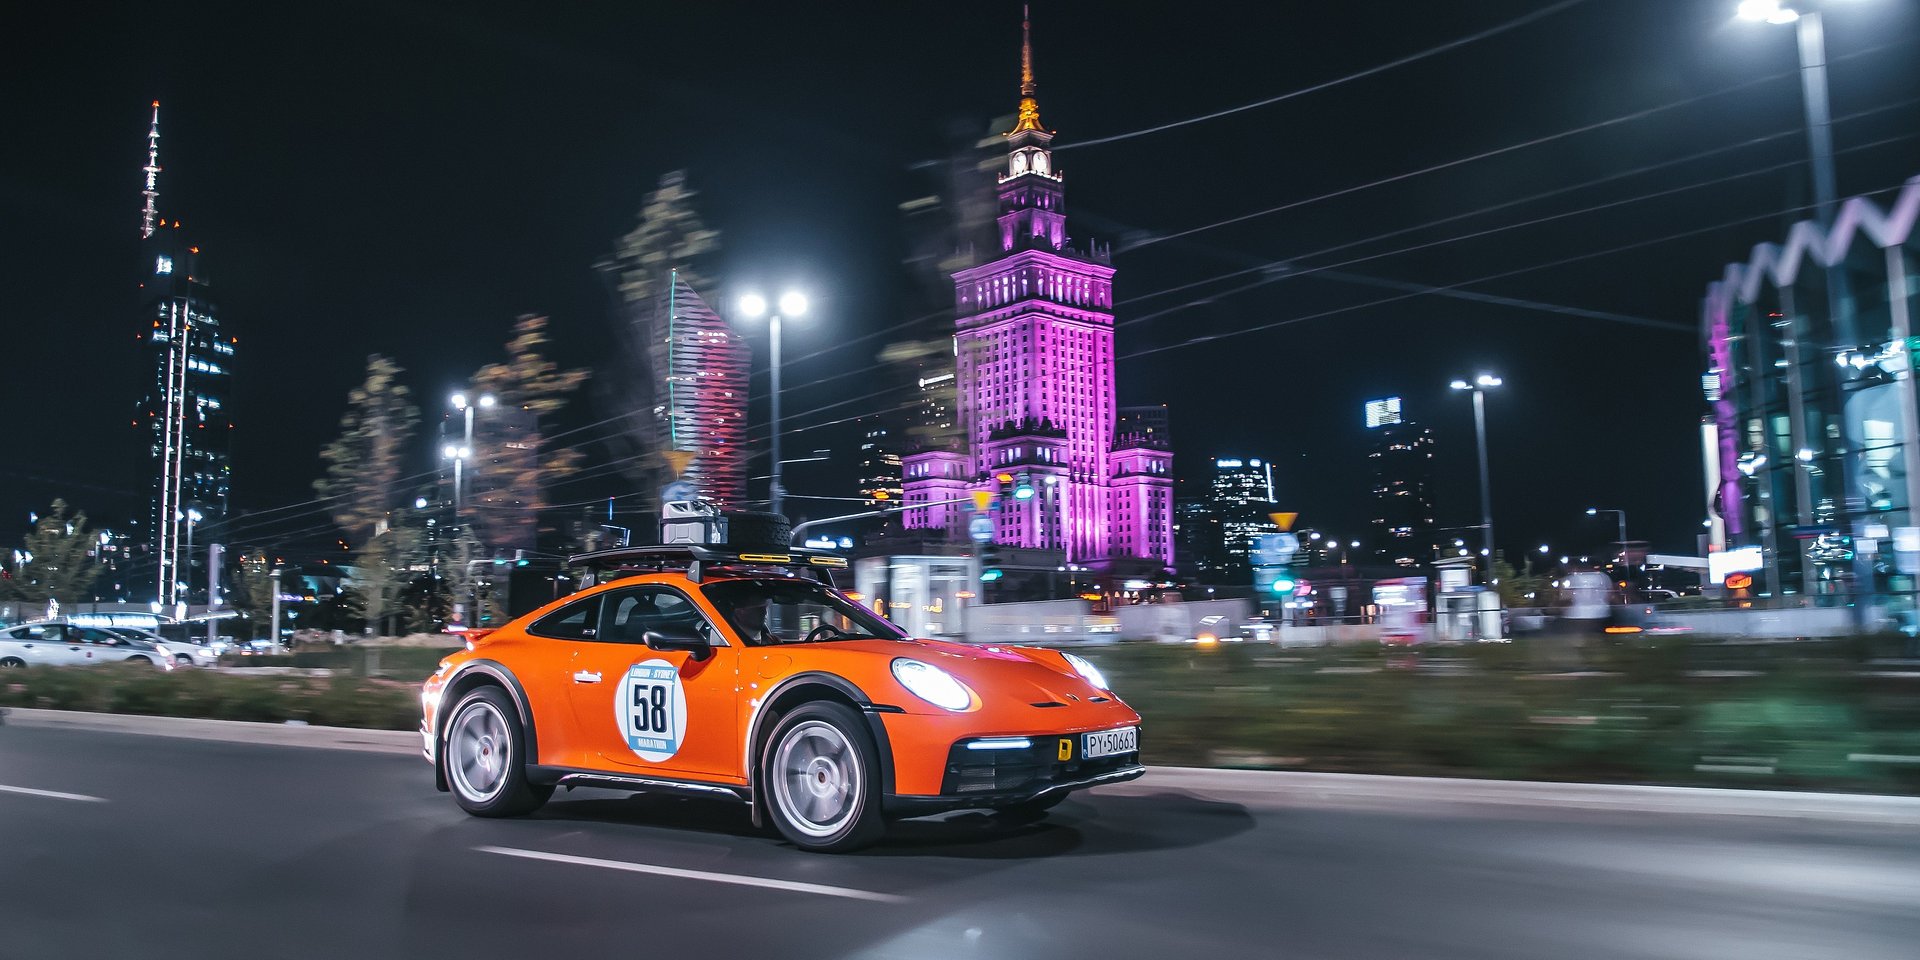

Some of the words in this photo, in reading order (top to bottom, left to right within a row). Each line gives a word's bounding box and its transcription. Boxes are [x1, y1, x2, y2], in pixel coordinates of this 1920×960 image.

[654, 669, 675, 679] SYDNEY
[634, 684, 667, 733] 58
[638, 738, 667, 750] MARATHON
[1090, 736, 1102, 755] PY
[1108, 731, 1134, 752] 50663
